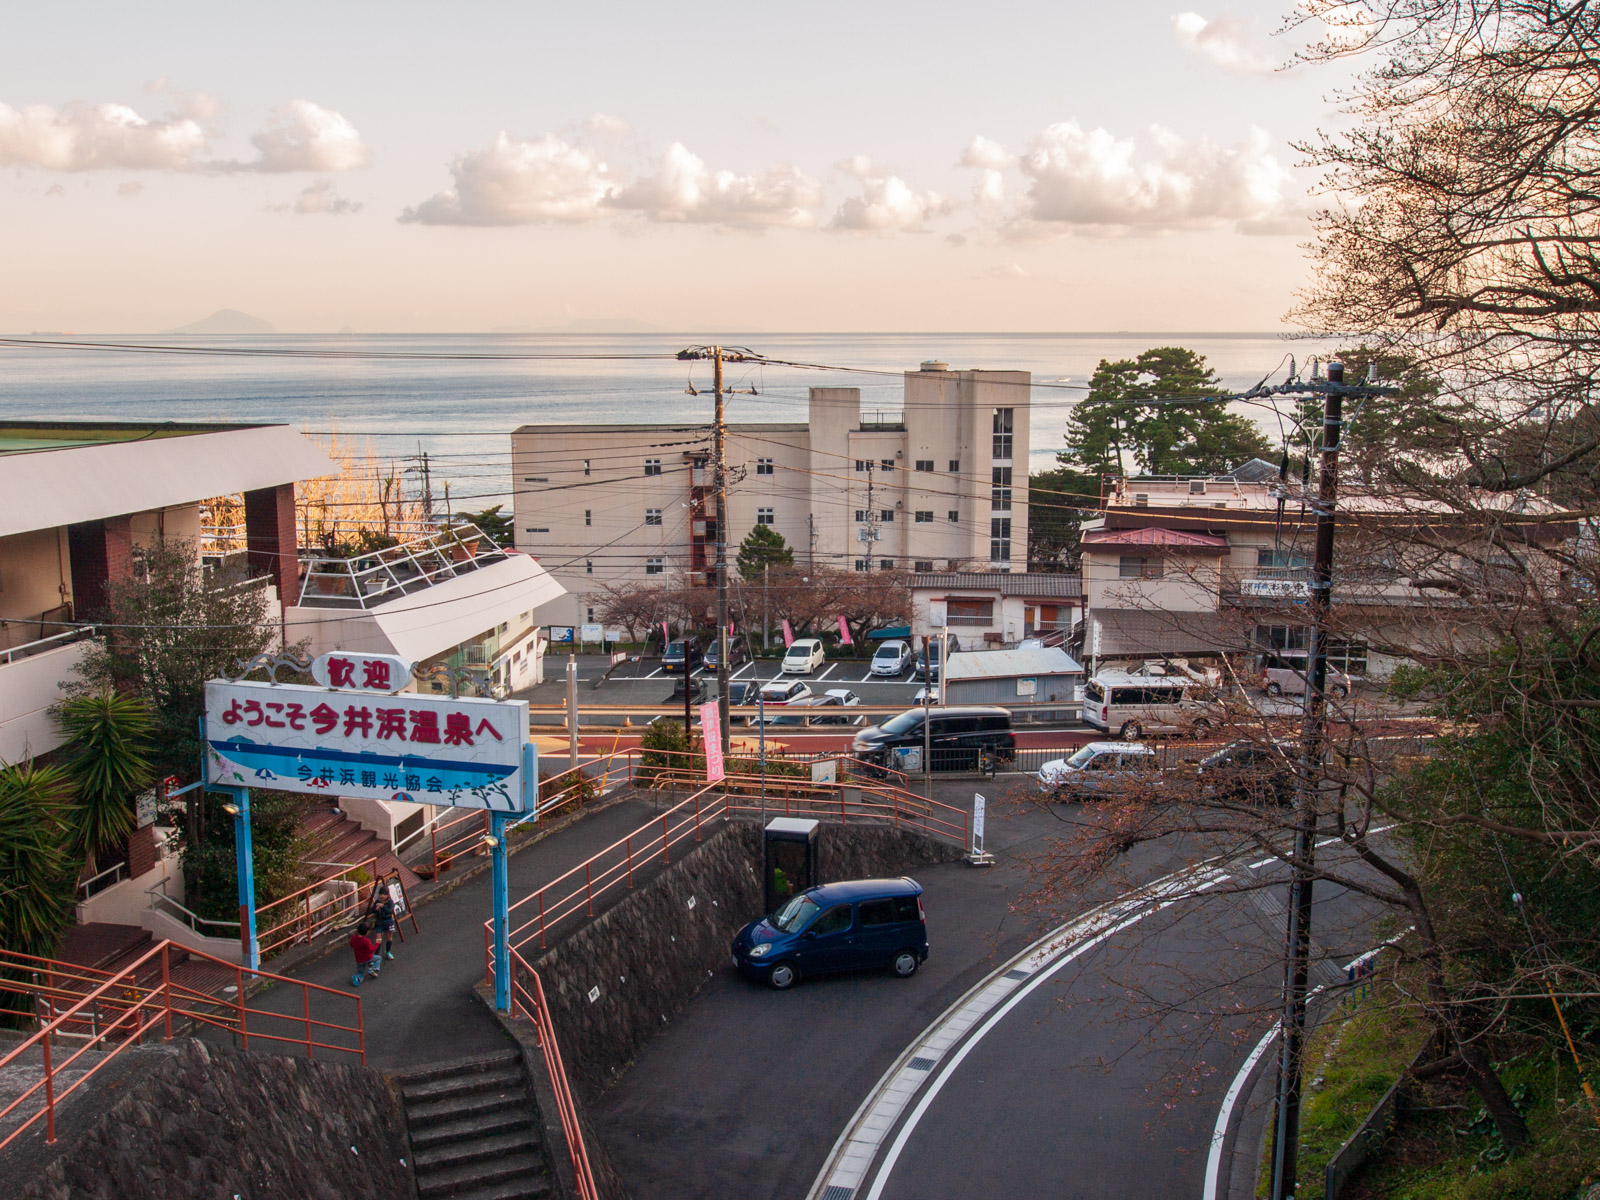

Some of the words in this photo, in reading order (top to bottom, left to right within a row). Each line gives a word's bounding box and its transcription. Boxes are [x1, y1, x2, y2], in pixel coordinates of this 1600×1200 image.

[327, 657, 391, 690] 歓迎
[222, 699, 503, 747] ようこそ今井浜温泉へ
[297, 764, 444, 794] 今井浜観光協会
